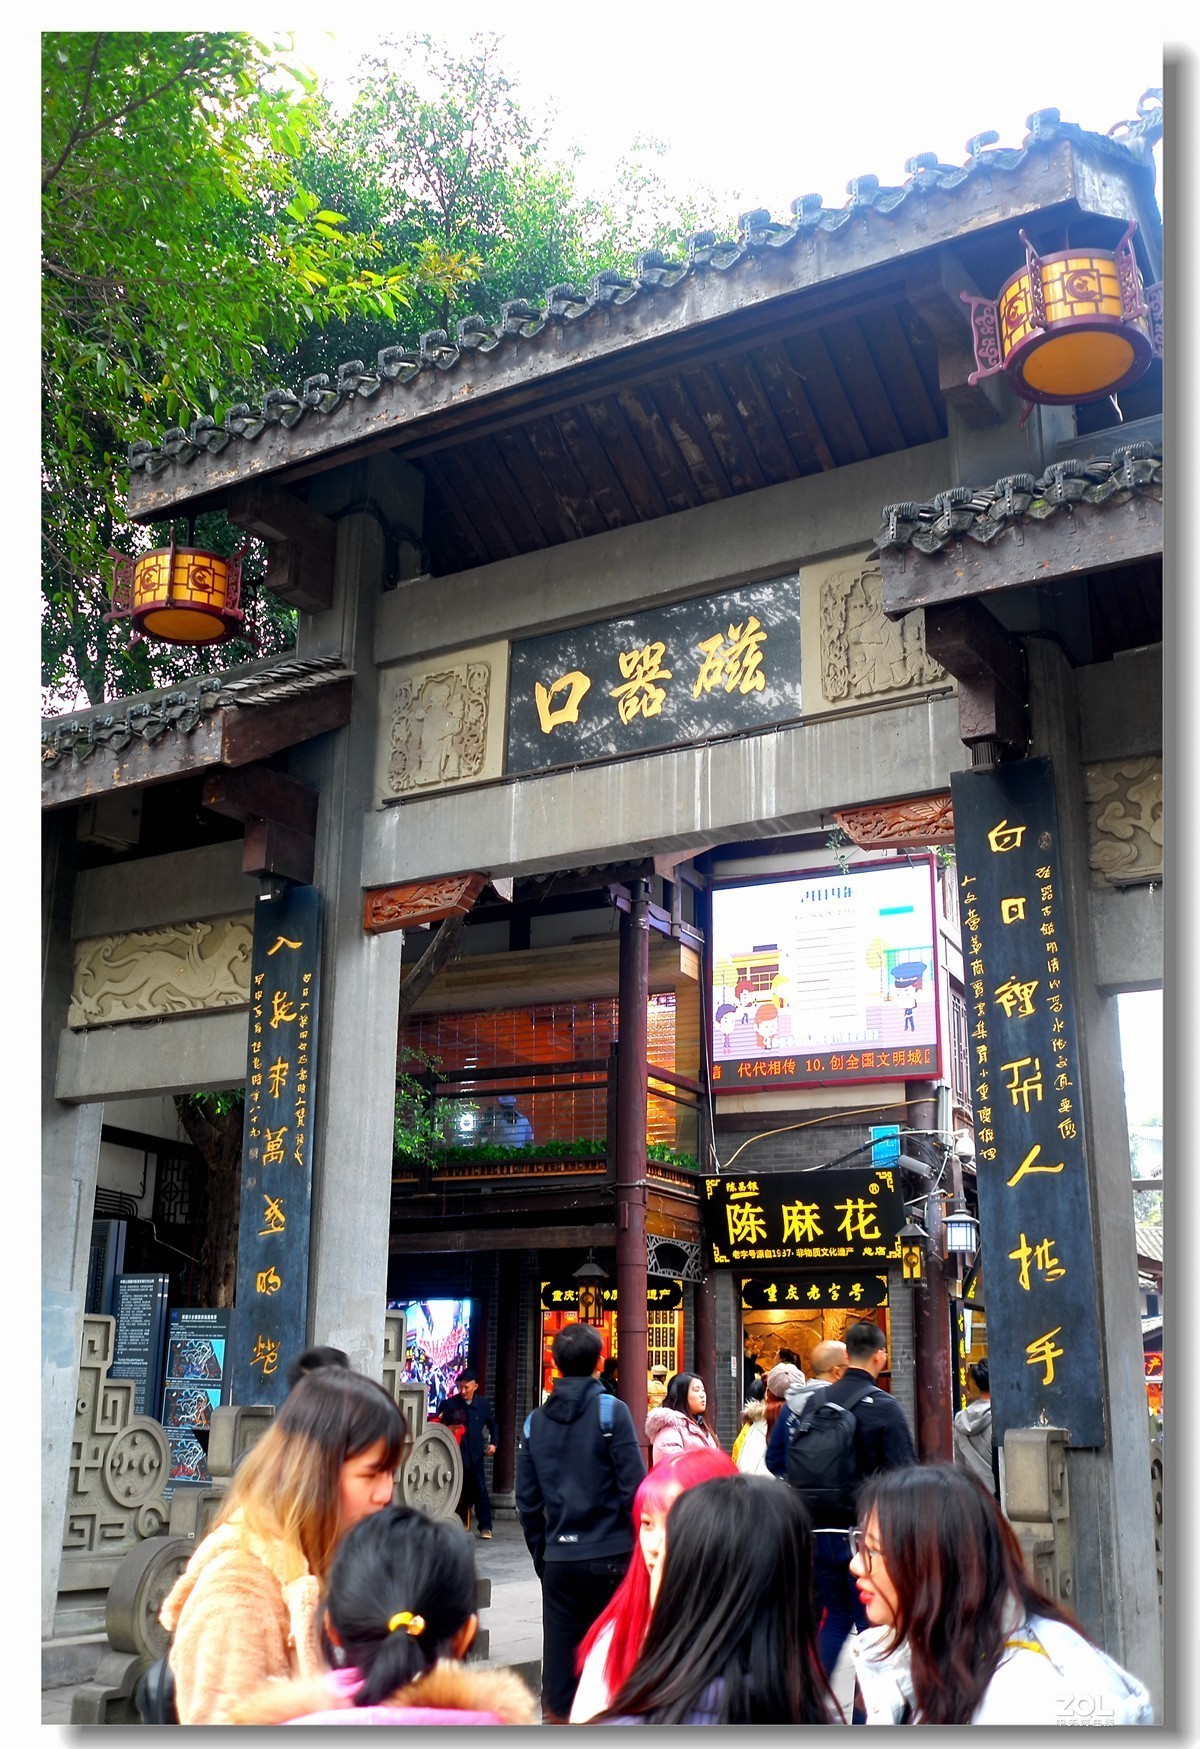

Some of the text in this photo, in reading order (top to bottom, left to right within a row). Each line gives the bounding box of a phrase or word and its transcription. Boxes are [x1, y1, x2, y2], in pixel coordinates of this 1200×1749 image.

[534, 615, 768, 735] 磁器口
[738, 1060, 796, 1078] 代代相传
[725, 1198, 882, 1246] 陈麻花
[763, 1283, 865, 1302] 重庆老字号
